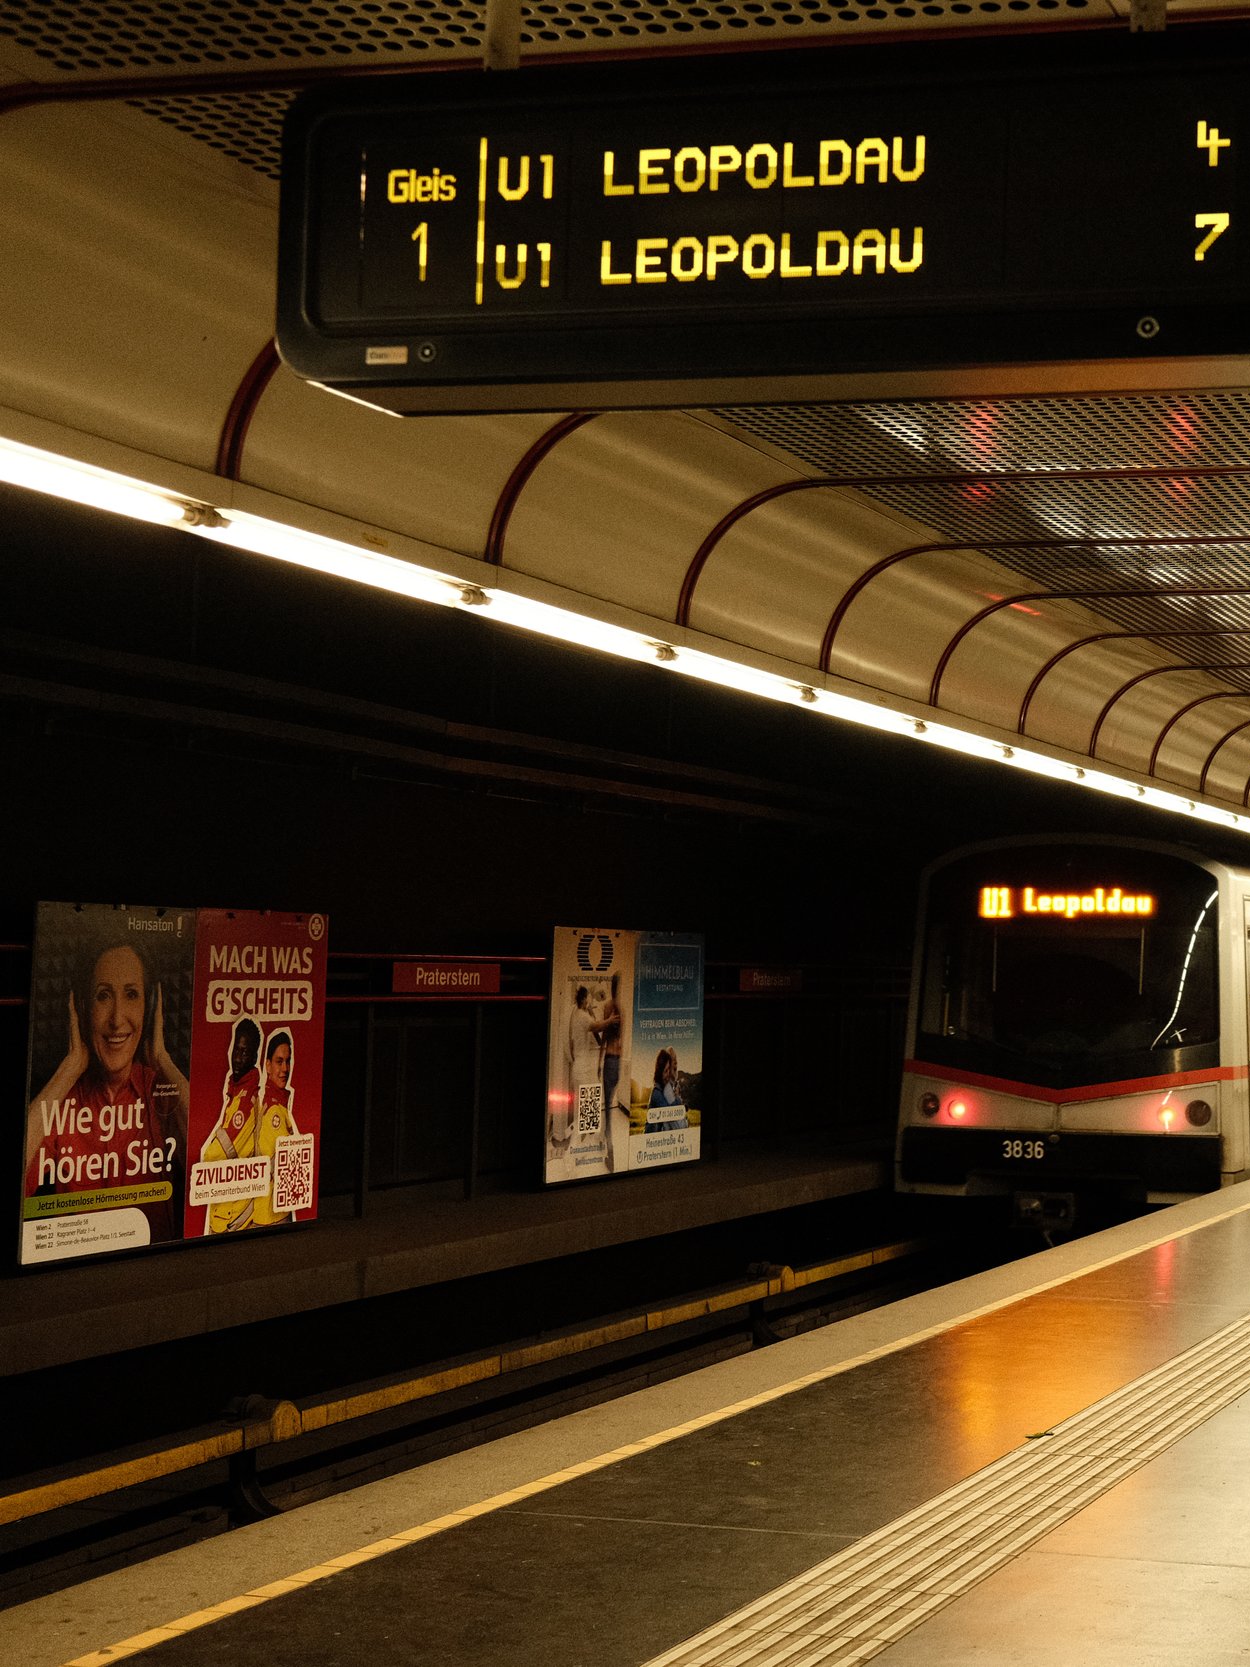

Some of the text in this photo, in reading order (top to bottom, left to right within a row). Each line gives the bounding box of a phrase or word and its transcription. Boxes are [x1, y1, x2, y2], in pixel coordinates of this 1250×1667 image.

[498, 120, 1231, 201] U1 LEOPOLDAU 4
[387, 167, 457, 204] Gleis
[411, 221, 427, 282] 1
[495, 212, 1230, 289] U1 LEOPOLDAU 7
[981, 886, 1154, 919] U1 Leopoldau
[127, 916, 174, 932] Hansaton
[209, 944, 313, 975] MACH WAS
[415, 967, 481, 987] Praterstern
[752, 970, 792, 987] Praterstern
[210, 986, 309, 1016] G'SCHEITS
[41, 1097, 145, 1144] Wie gut
[278, 1139, 289, 1148] Jetzt
[1002, 1140, 1045, 1159] 3836
[38, 1137, 176, 1187] hören Sie?
[195, 1162, 267, 1186] ZIVILDIENST
[37, 1186, 167, 1211] Jetzt kostenlose Hörmessung machen!
[194, 1183, 266, 1200] beim Samariterbund Wien
